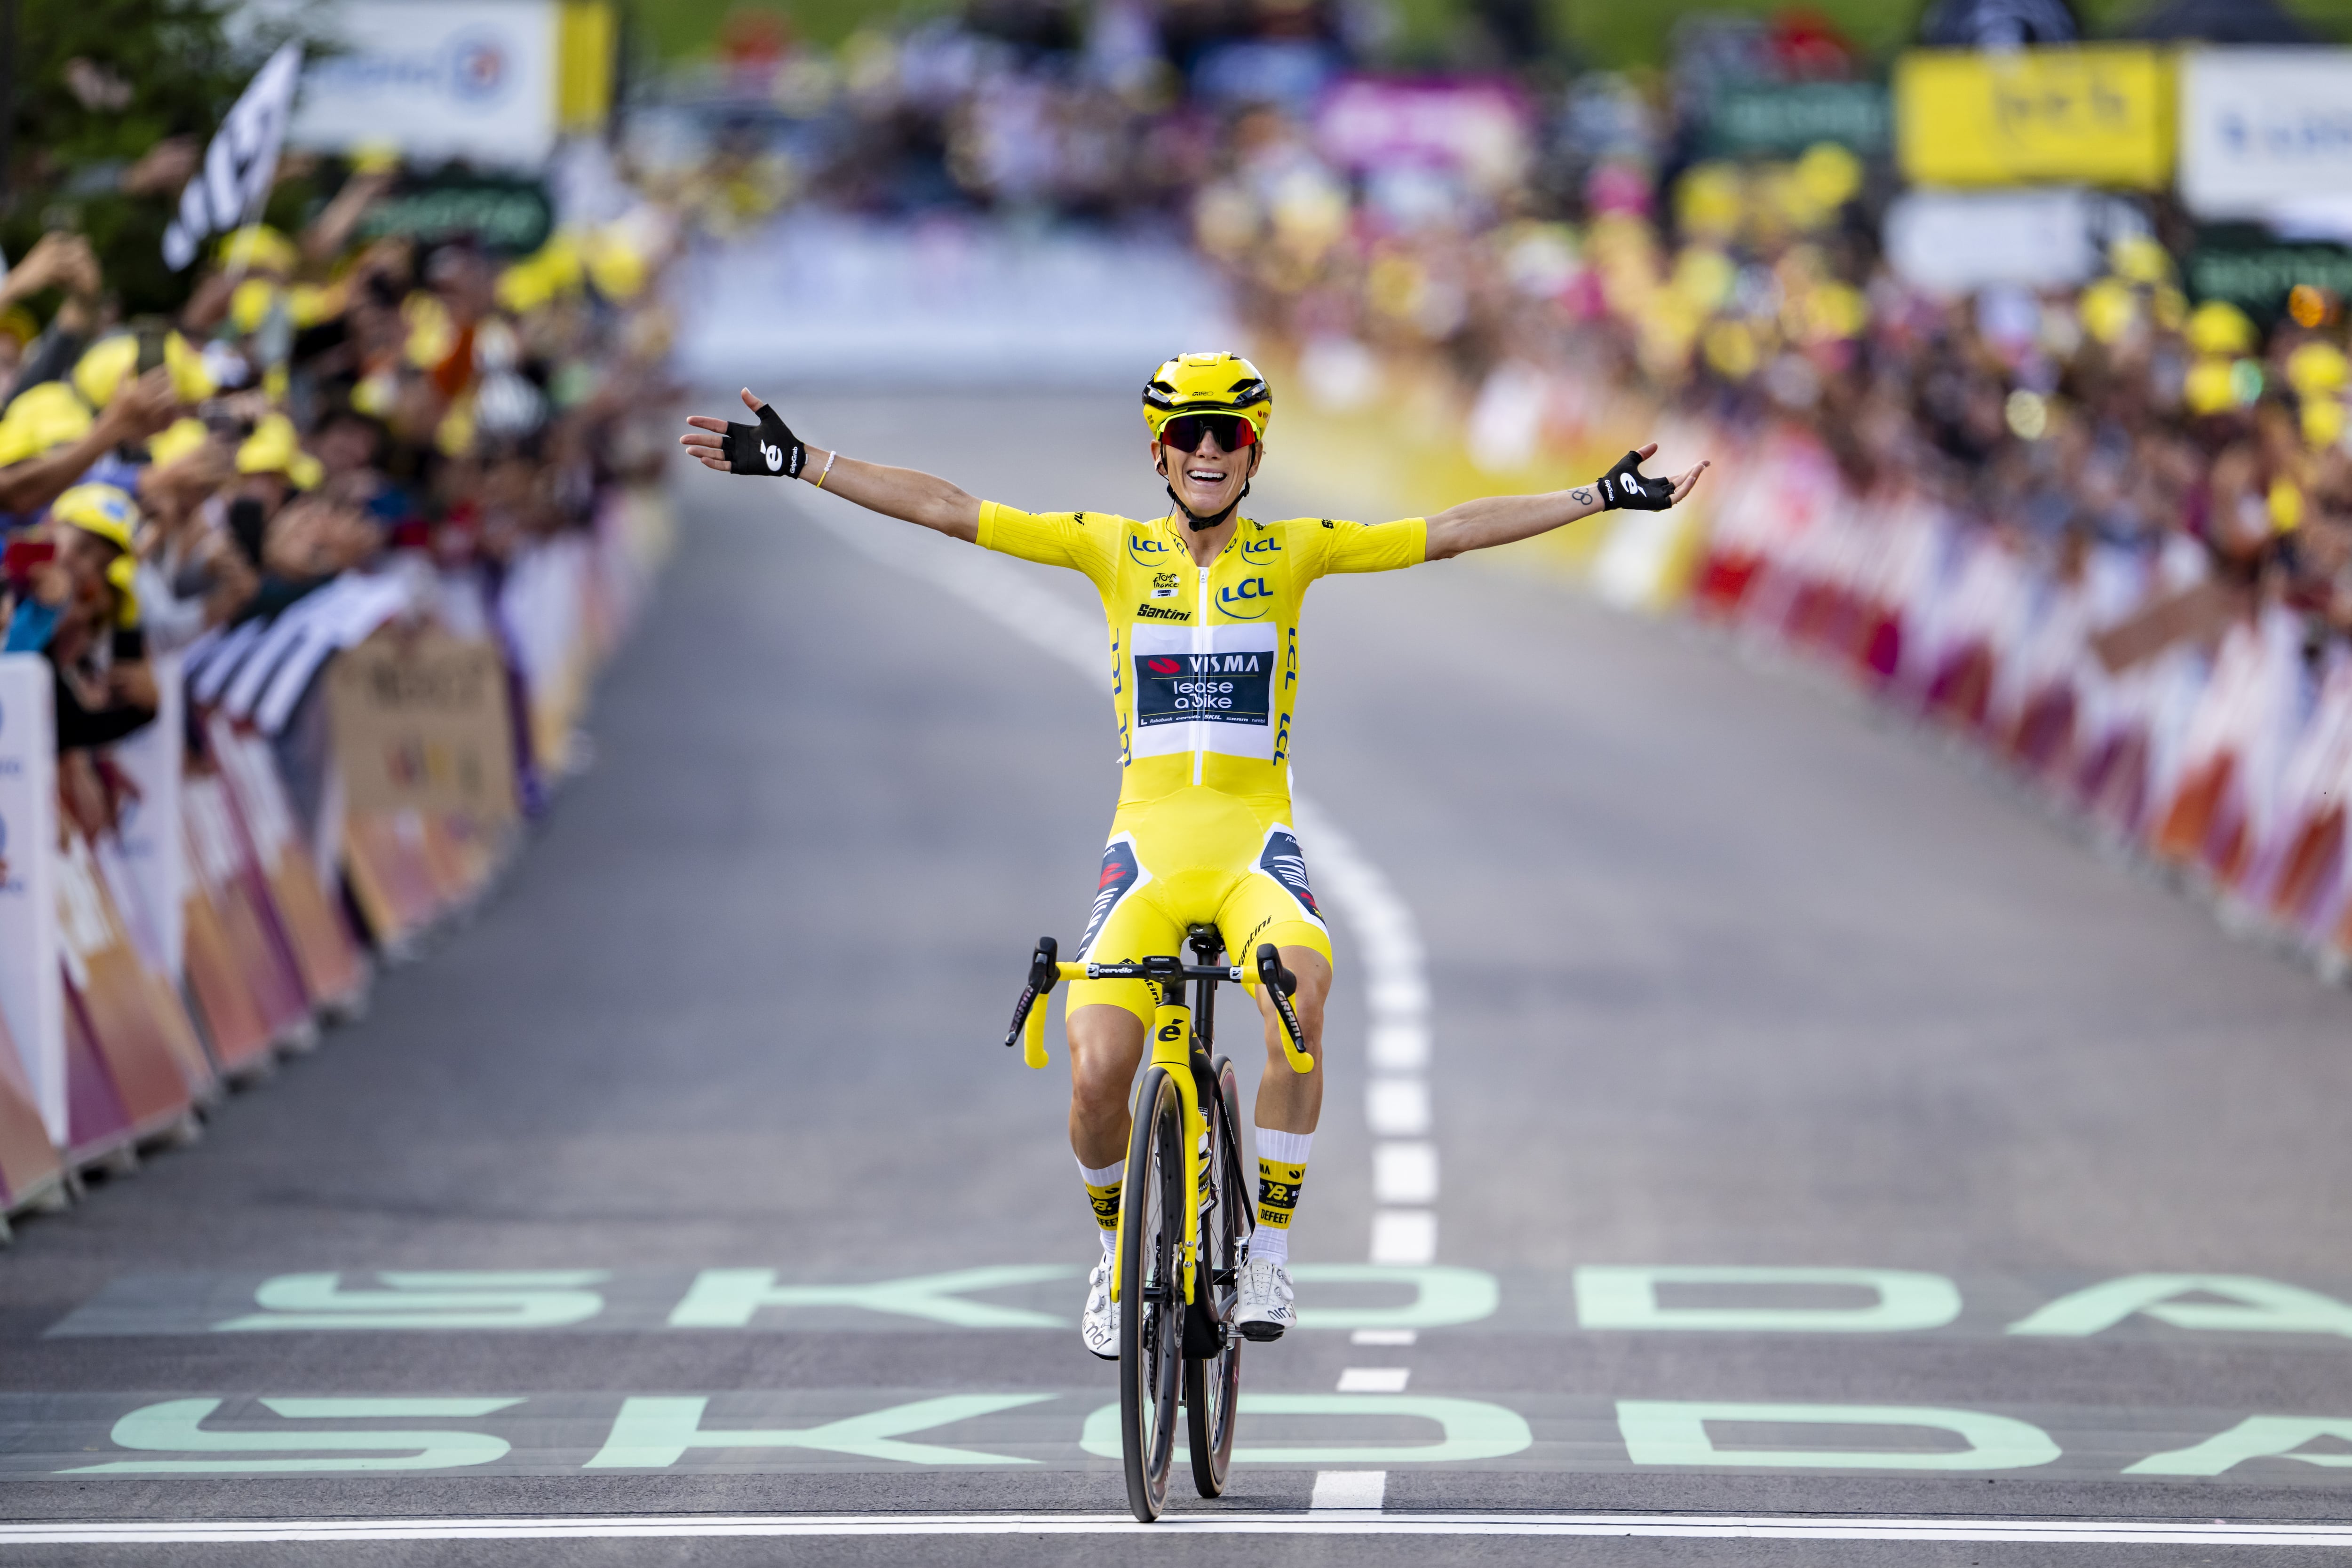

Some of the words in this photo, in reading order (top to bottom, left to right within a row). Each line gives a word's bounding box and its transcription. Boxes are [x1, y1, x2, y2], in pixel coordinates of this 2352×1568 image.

[1132, 535, 1169, 552] LCL
[1245, 537, 1282, 553] LCL
[1222, 578, 1273, 602] LCL
[1136, 603, 1192, 621] Santini
[1112, 628, 1122, 696] LCL
[1189, 655, 1260, 673] VISMA
[1285, 627, 1296, 690] LCL
[1174, 681, 1233, 695] lease
[1120, 713, 1132, 768] LCL
[1273, 713, 1290, 766] LCL
[1276, 990, 1301, 1037] SRAM
[1261, 1209, 1290, 1224] DEFEET
